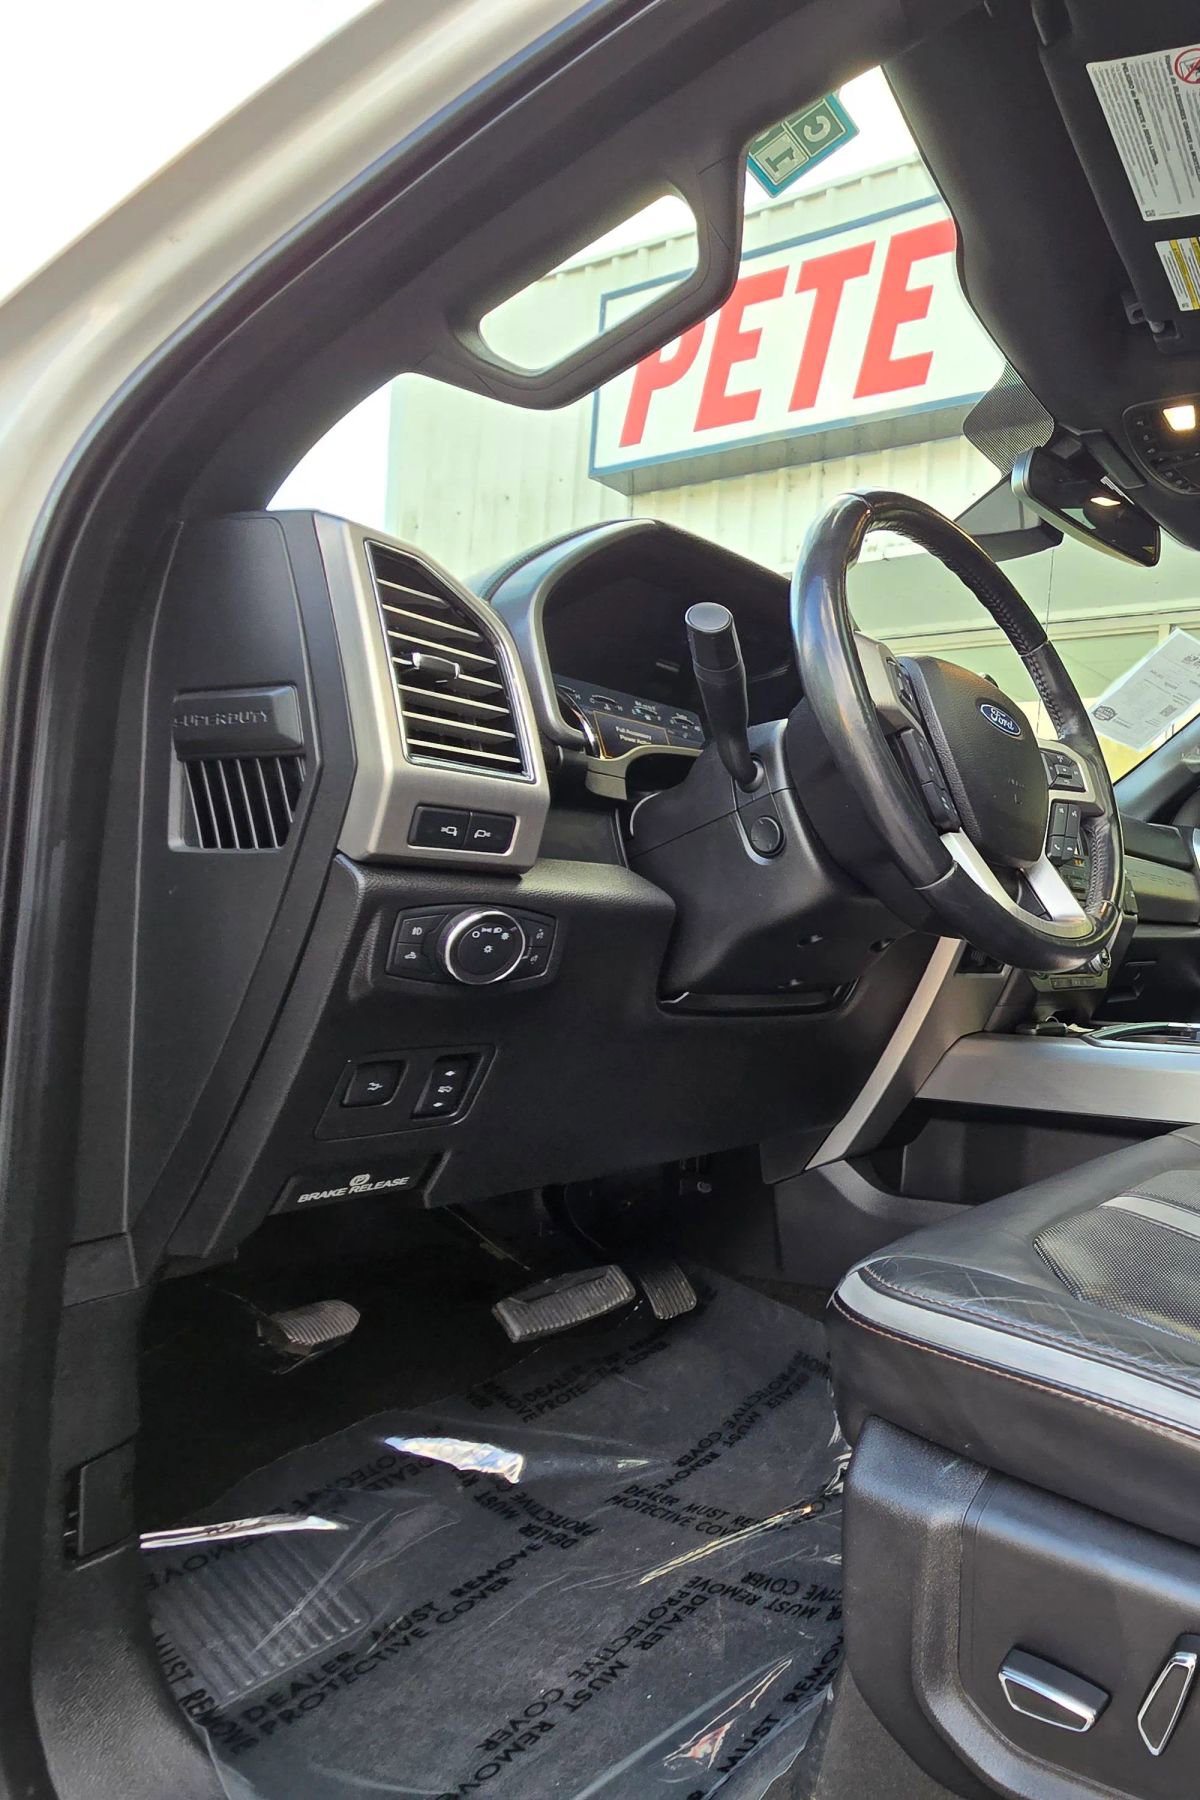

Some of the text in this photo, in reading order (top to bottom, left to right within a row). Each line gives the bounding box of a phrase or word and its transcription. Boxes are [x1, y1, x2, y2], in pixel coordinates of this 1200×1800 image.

[619, 218, 957, 448] PETE
[989, 706, 1016, 732] Ford
[297, 1177, 410, 1203] BRAKE RELEASE
[722, 1410, 761, 1448] MUST
[673, 1431, 722, 1467] COVER
[473, 1490, 520, 1520] MUST
[682, 1503, 730, 1523] MUST
[435, 1575, 516, 1625] COVER
[684, 1575, 762, 1606] REMOVE
[739, 1570, 801, 1596] COVER
[634, 1594, 710, 1652] DEALER
[763, 1597, 822, 1621] MUST
[240, 1650, 354, 1722] DEALER
[449, 1541, 546, 1598] REMOVE
[563, 1659, 630, 1714] MUST
[475, 1687, 565, 1751] COVER
